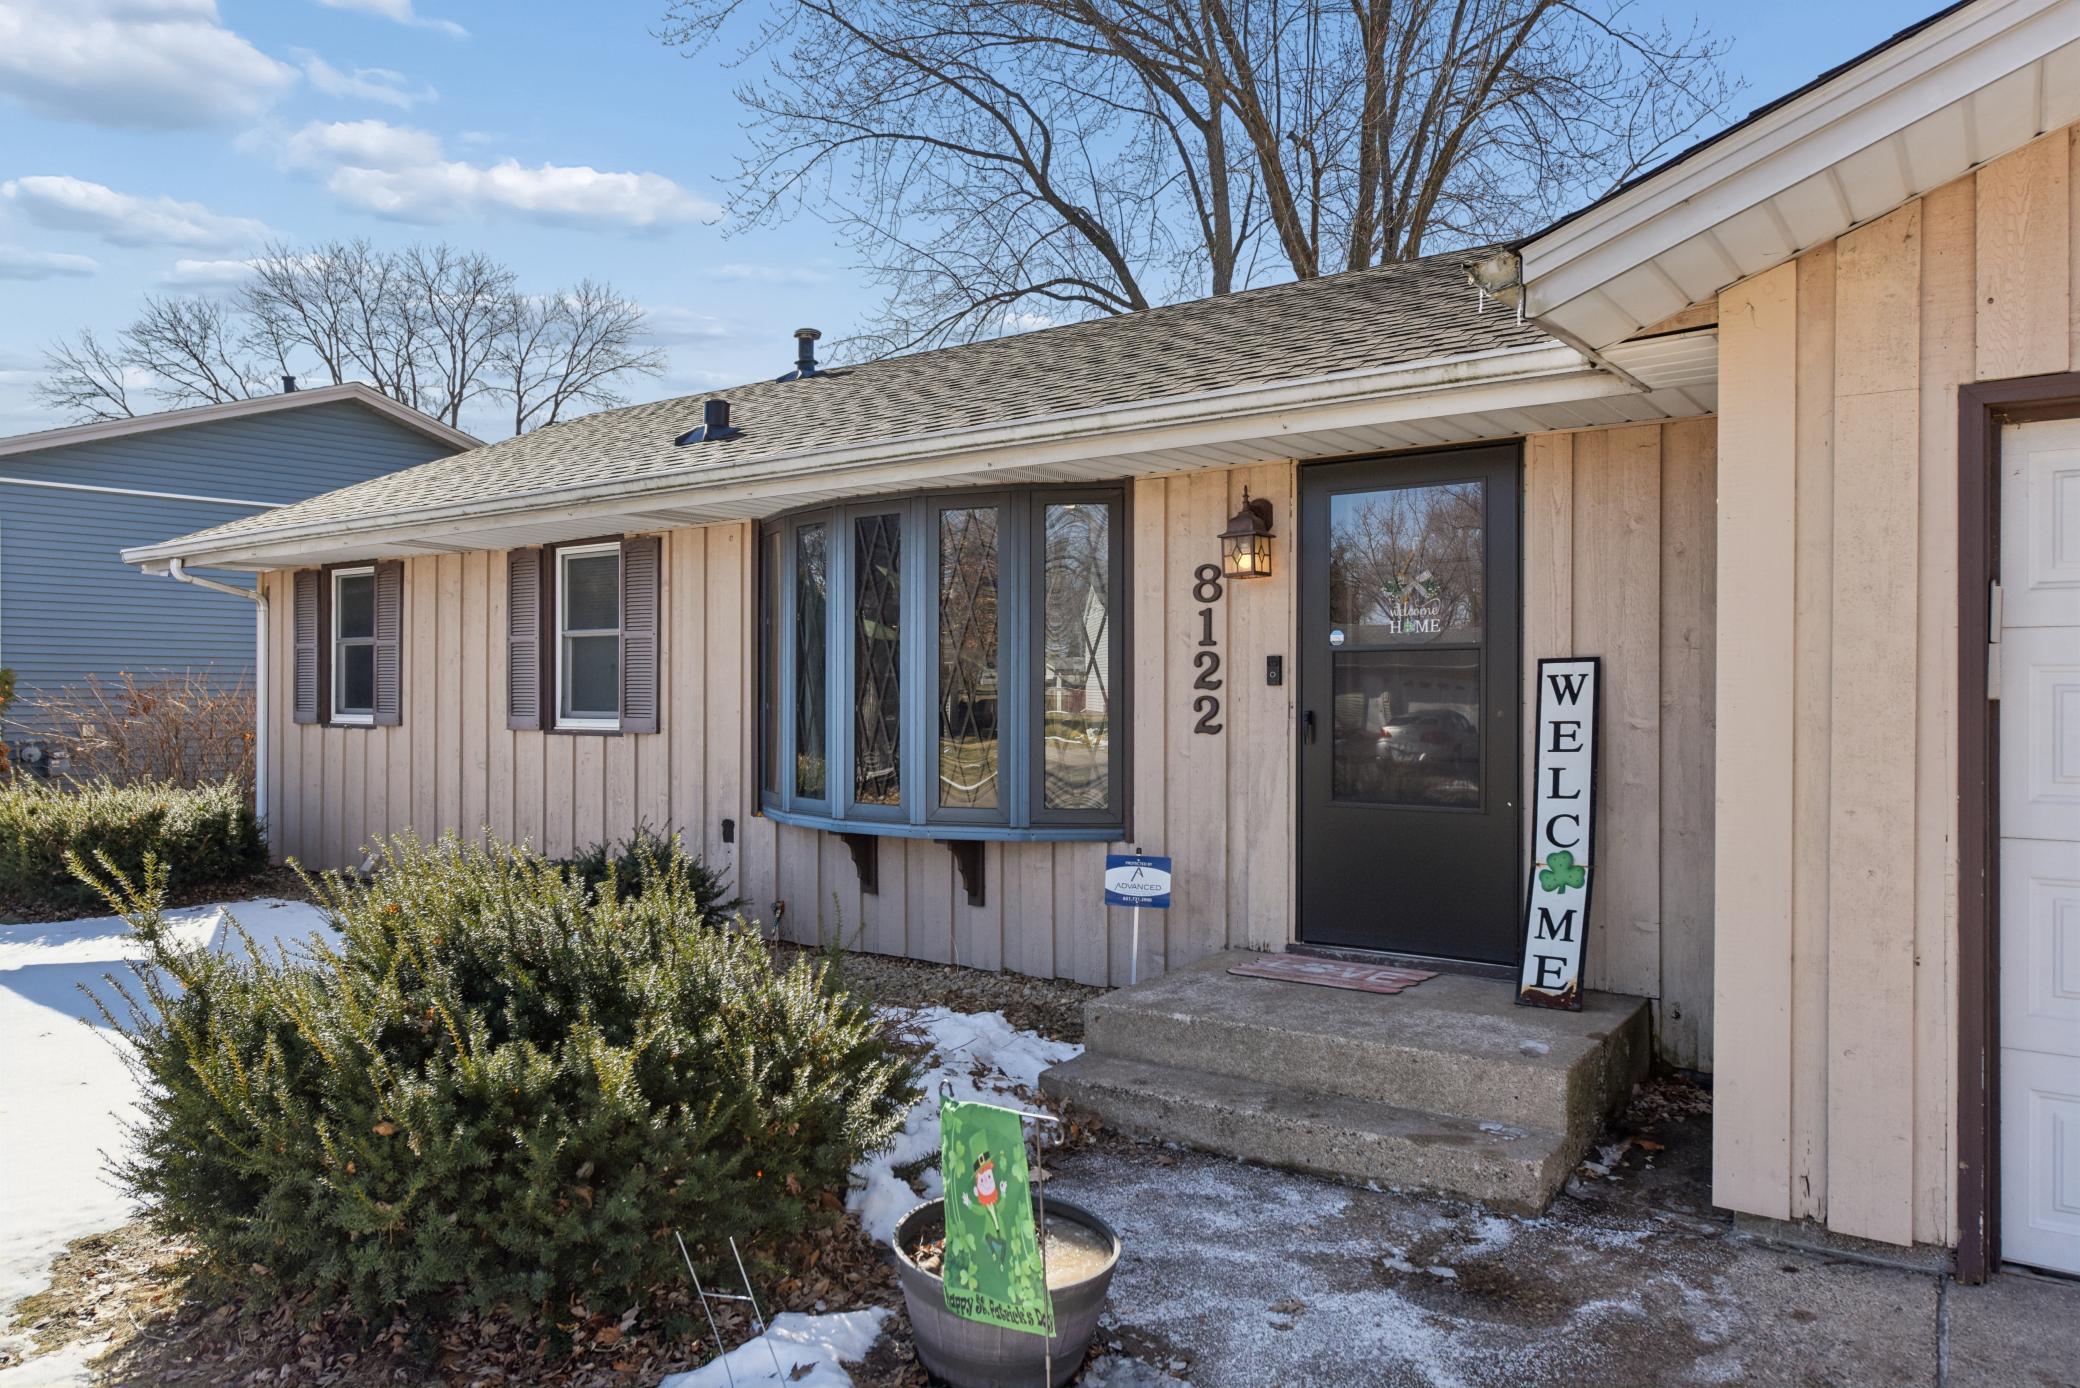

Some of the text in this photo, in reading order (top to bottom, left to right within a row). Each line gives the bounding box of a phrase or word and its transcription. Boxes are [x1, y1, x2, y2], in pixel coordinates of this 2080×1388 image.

[1389, 618, 1441, 634] HME
[1193, 563, 1223, 735] 8122
[1530, 673, 1589, 990] WELCME
[1114, 882, 1162, 891] ADVANCED
[1265, 960, 1406, 984] LVE
[976, 1293, 990, 1316] St.
